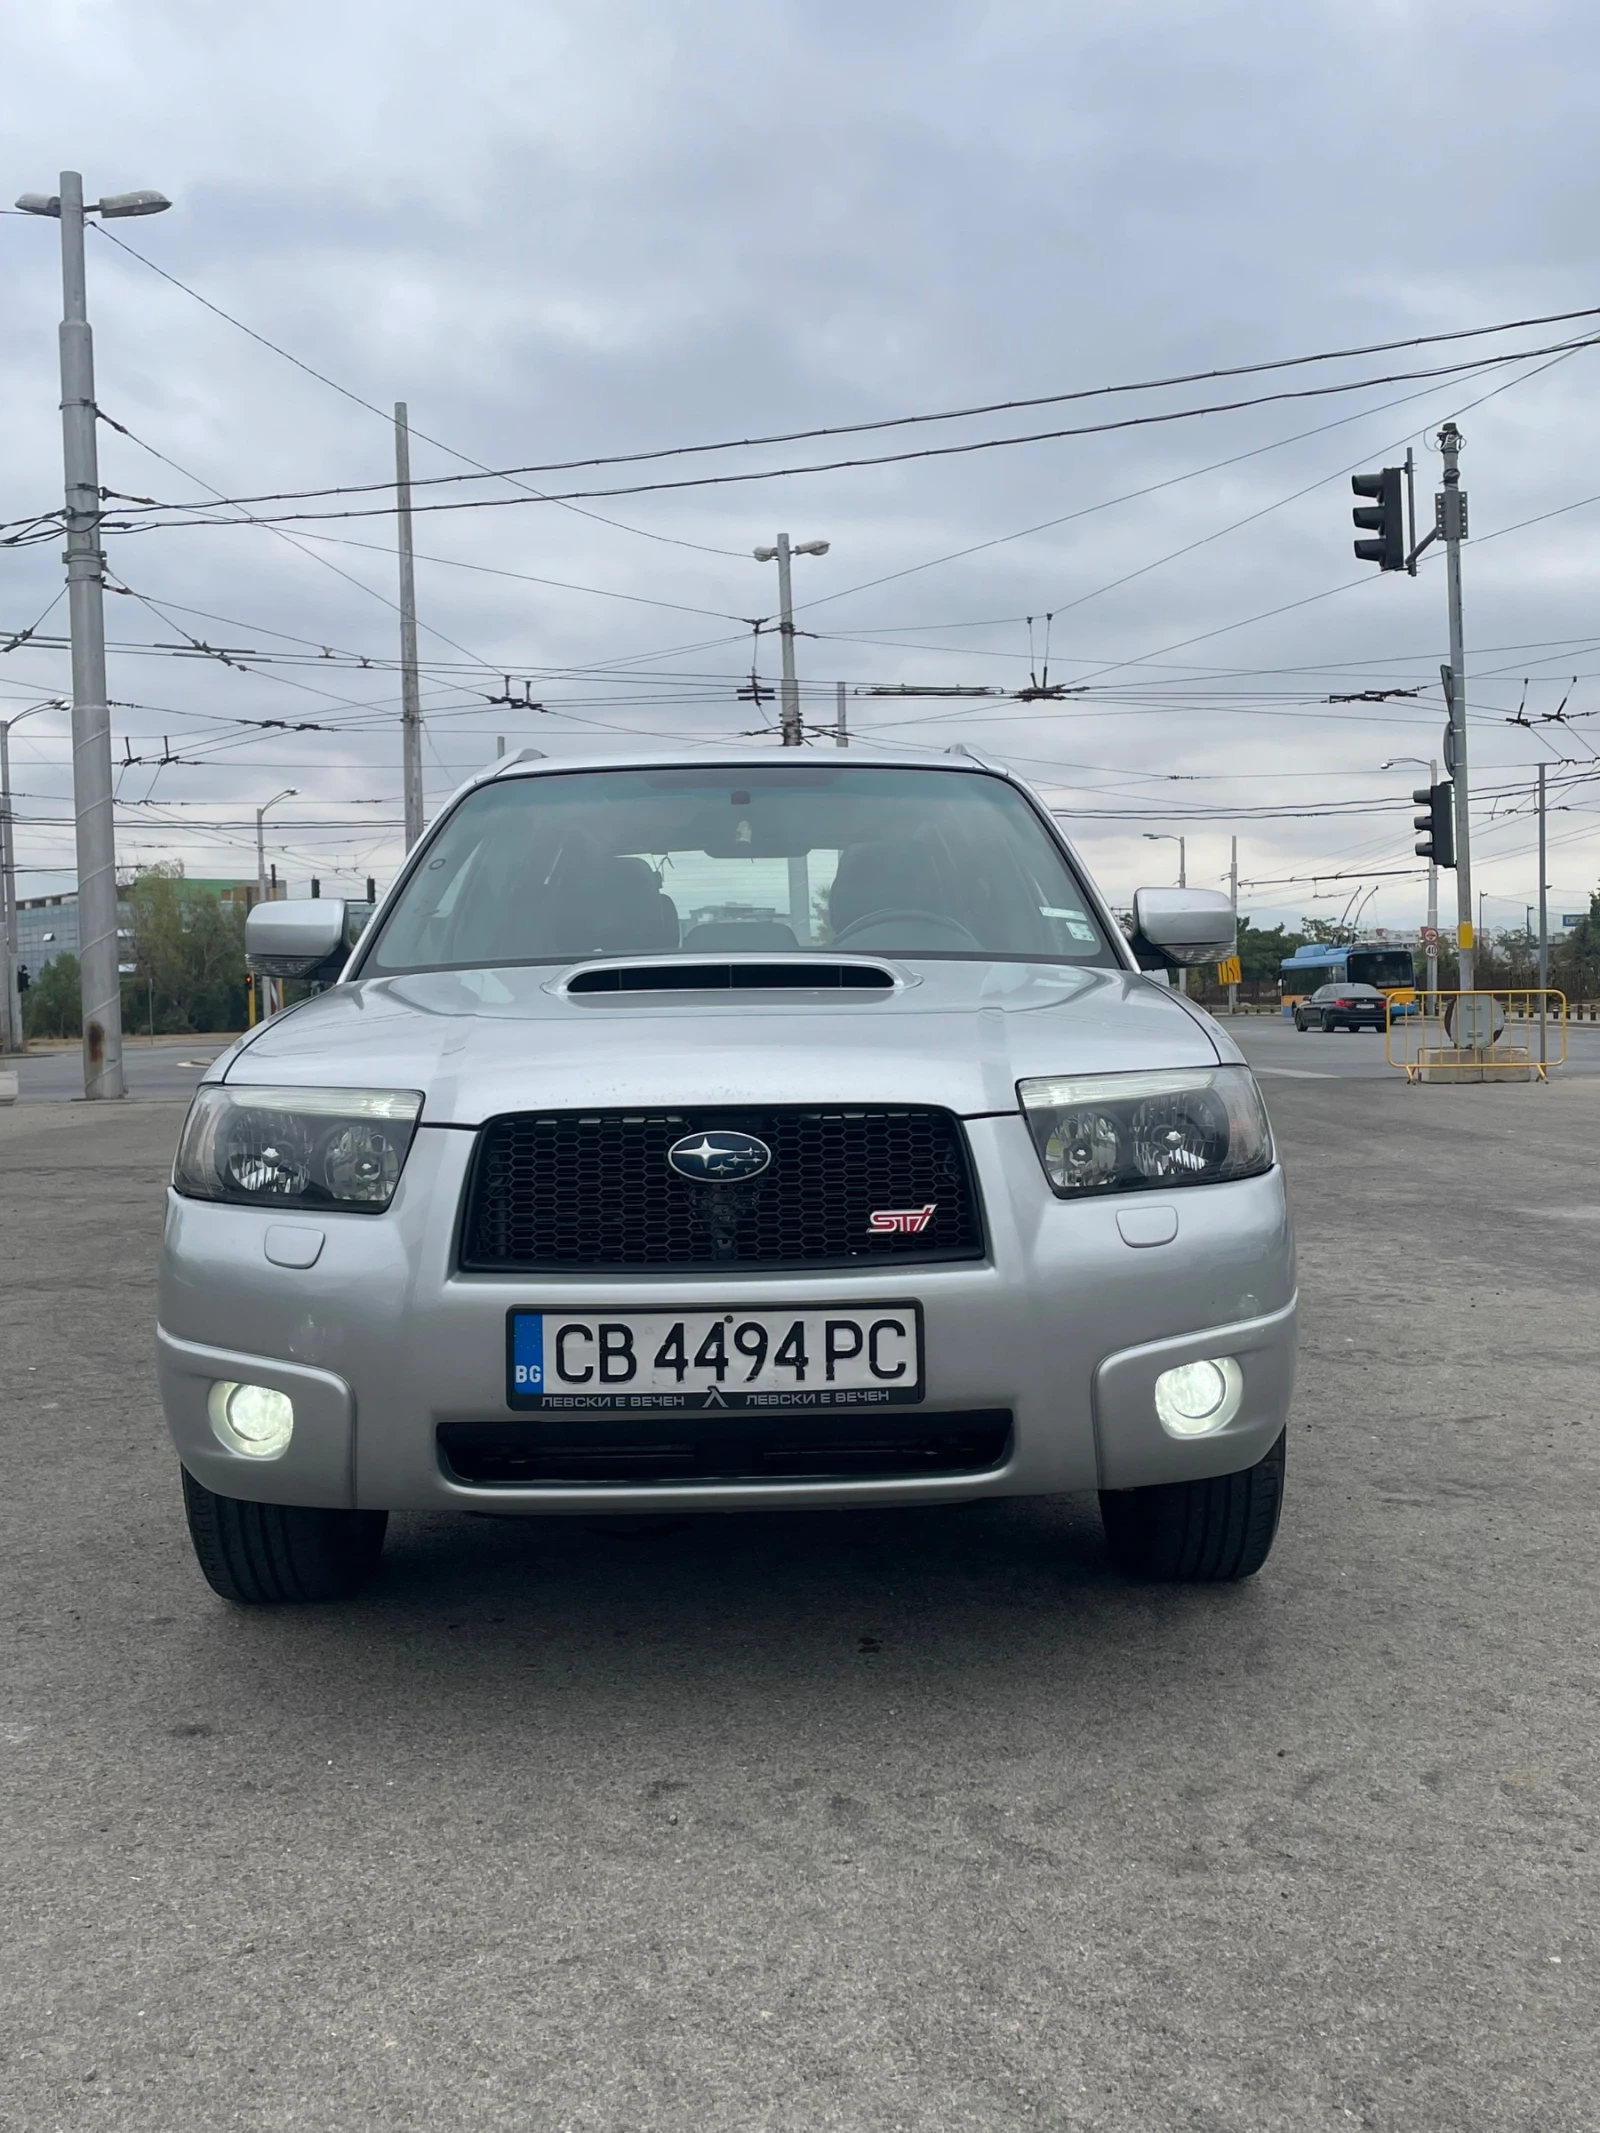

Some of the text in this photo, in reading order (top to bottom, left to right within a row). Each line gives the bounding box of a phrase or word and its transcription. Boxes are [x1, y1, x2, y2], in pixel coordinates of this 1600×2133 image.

[1427, 946, 1436, 954] 40
[653, 1320, 809, 1384] 4494
[515, 1364, 541, 1384] BG
[541, 1395, 685, 1408] ЛЕВСКИ Е ВЕЧЕН
[746, 1391, 889, 1405] ЛЕВСКИ Е ВЕЧЕН
